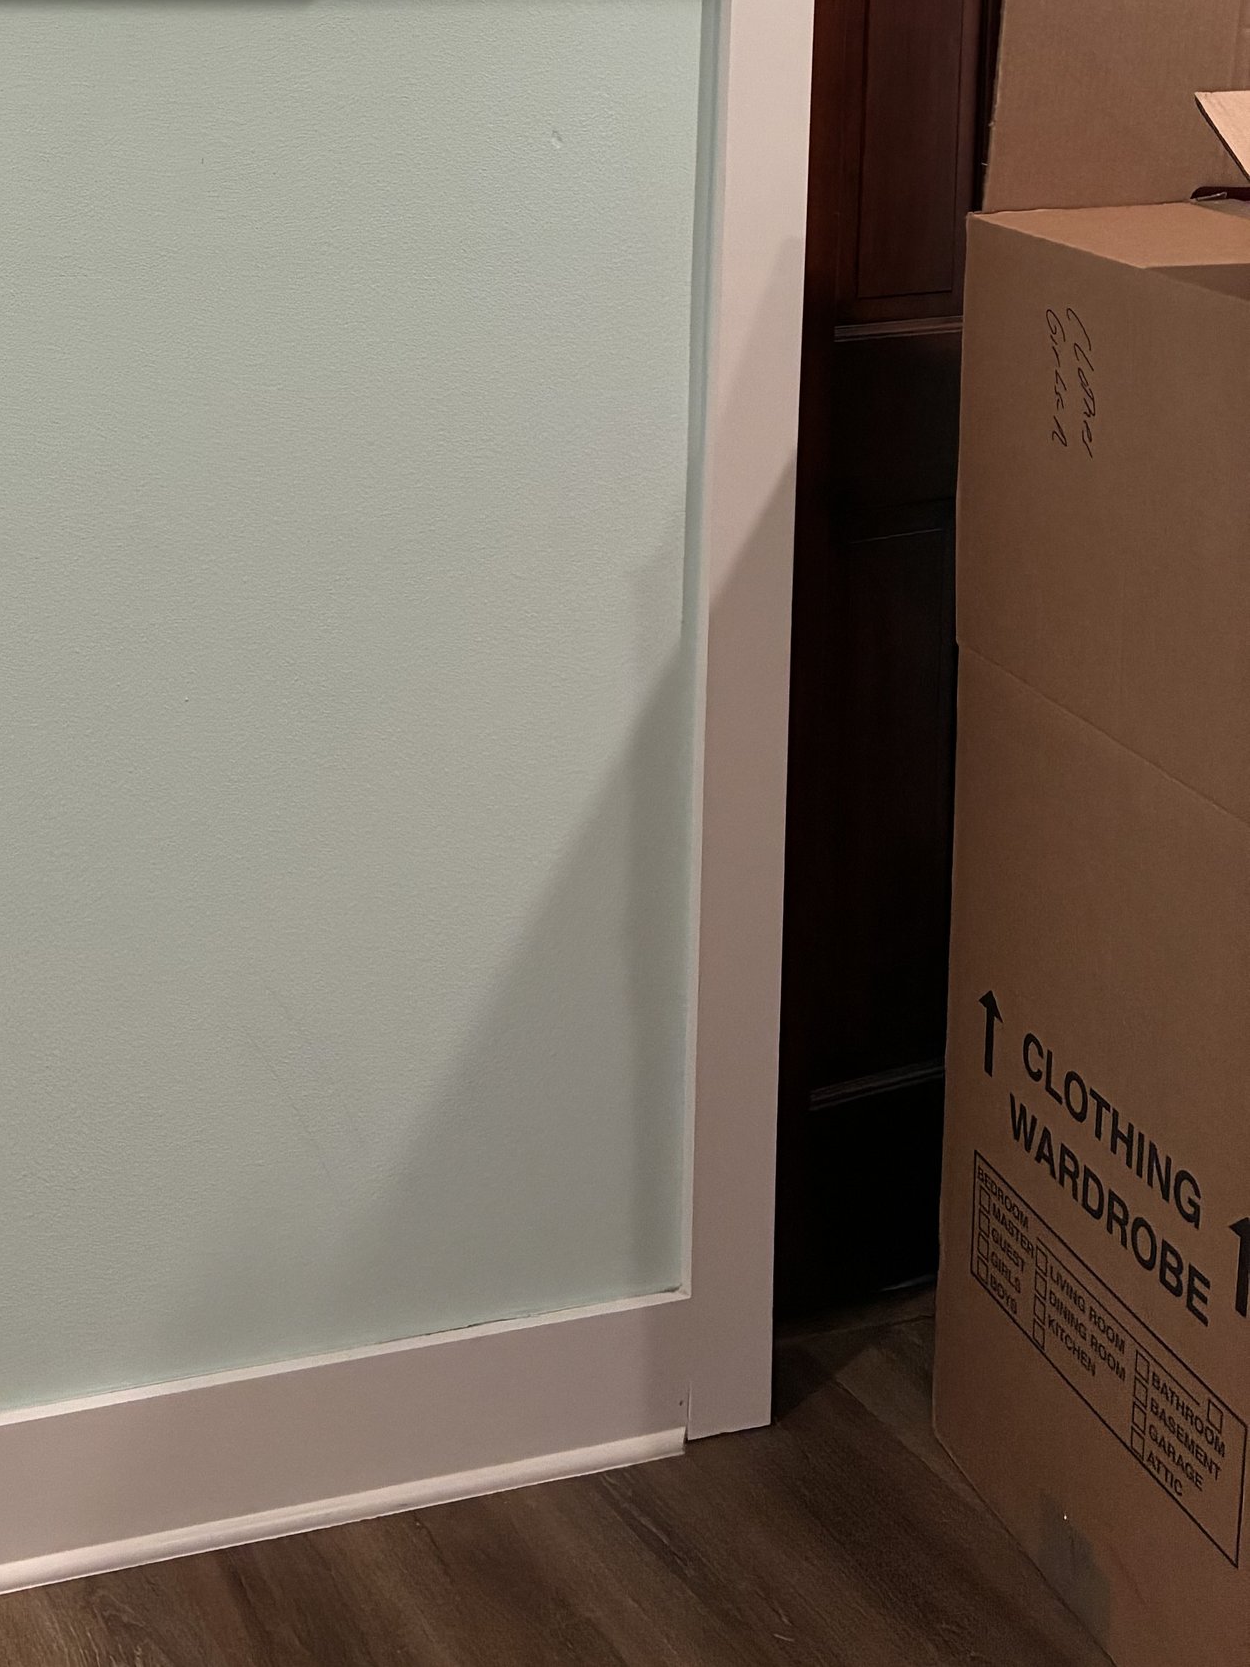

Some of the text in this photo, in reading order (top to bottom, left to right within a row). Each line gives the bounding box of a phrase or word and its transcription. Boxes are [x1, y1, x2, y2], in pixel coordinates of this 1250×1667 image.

[1022, 1031, 1202, 1230] CLOTHING
[976, 1164, 1031, 1230] BEDROOM
[991, 1201, 1035, 1259] MASTER
[1009, 1091, 1212, 1328] WARDROBE
[990, 1225, 1027, 1273] GUEST
[990, 1249, 1022, 1295] GIRLS
[989, 1273, 1019, 1316] BOYS
[1049, 1264, 1126, 1355] LIVING ROOM
[1047, 1312, 1097, 1378] KITCHEN
[1048, 1289, 1127, 1383] DINING ROOM
[1149, 1396, 1223, 1482] BASEMENT
[1151, 1370, 1227, 1459] BATHROOM
[1146, 1450, 1184, 1498] ATTIC
[1147, 1422, 1205, 1494] GARAGE
